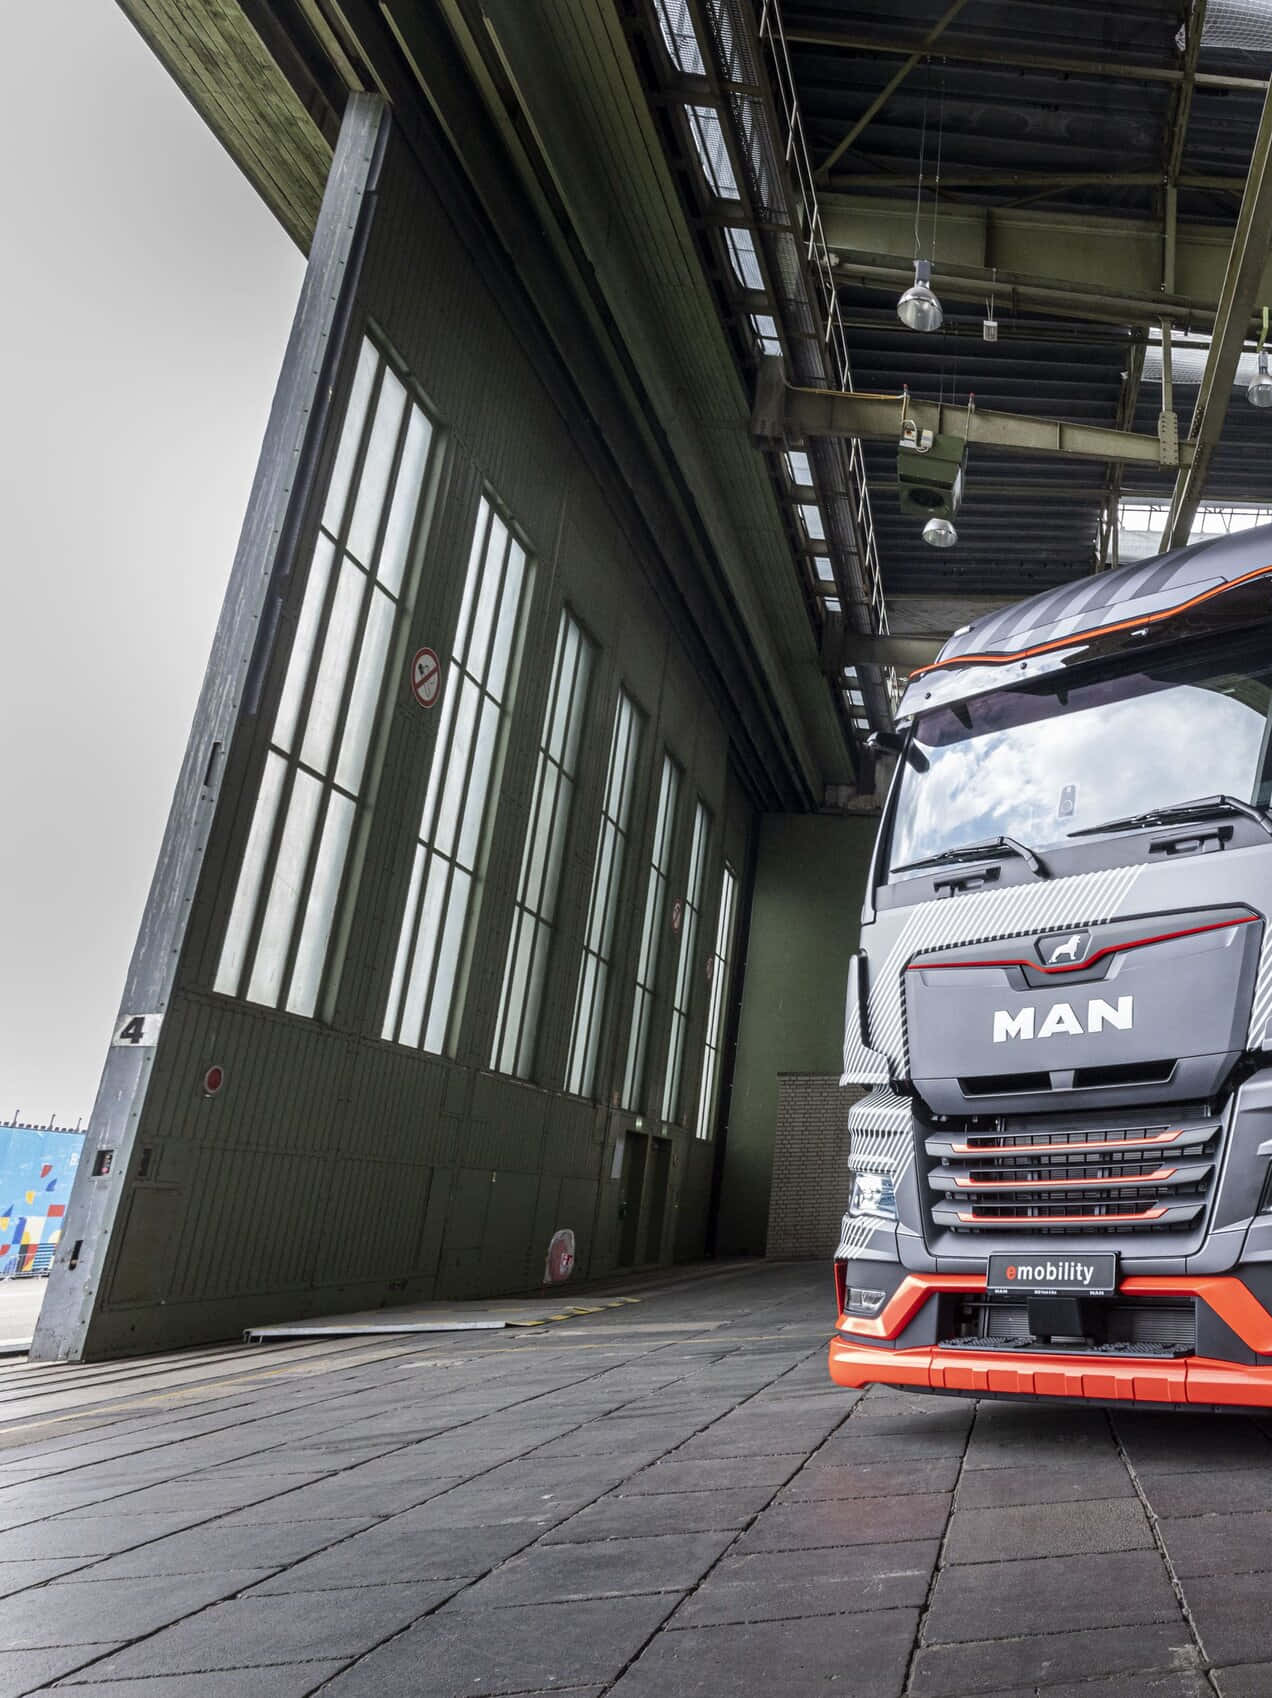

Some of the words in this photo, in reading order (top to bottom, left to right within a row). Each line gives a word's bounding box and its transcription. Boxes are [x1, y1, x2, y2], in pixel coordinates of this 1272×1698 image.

[120, 1017, 145, 1044] 4
[993, 996, 1133, 1042] MAN
[1006, 1262, 1094, 1285] emobility
